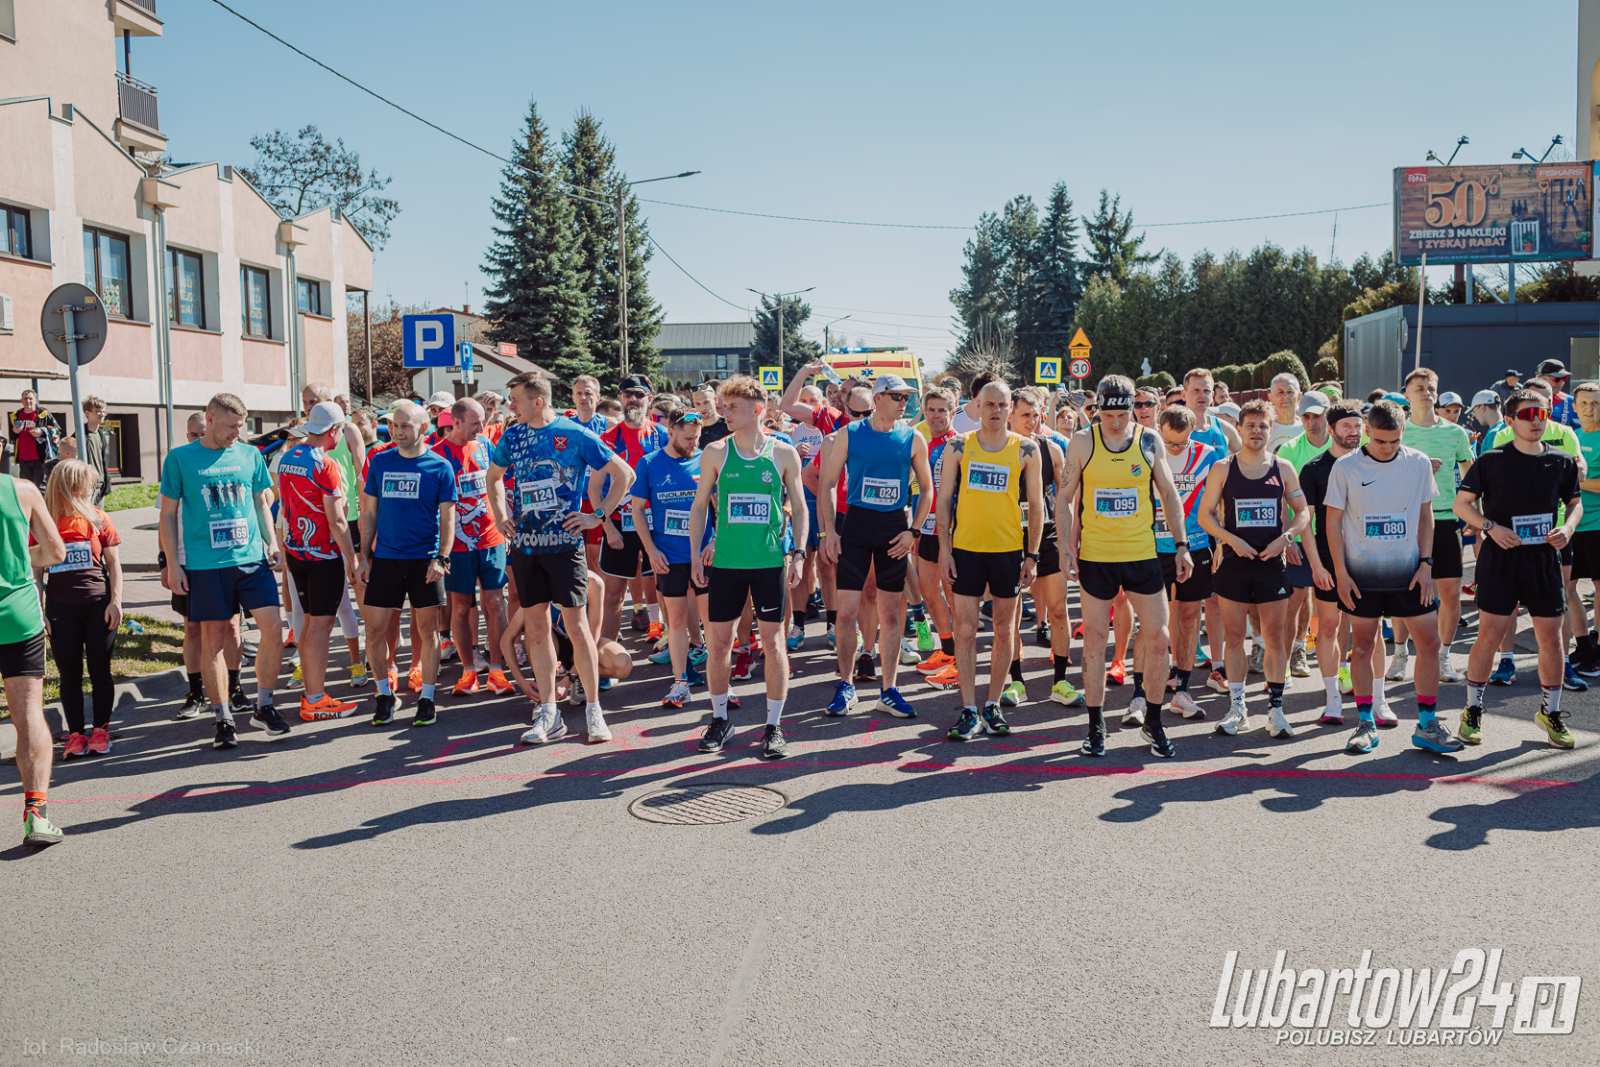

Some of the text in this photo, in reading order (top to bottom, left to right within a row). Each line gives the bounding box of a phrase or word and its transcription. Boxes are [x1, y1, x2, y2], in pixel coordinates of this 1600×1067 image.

[1409, 227, 1506, 239] ZBIERZ 3 NAKLEJKI
[1418, 237, 1507, 249] I ZYSKAJ RABAT
[415, 320, 444, 361] P
[1072, 363, 1088, 375] 30
[986, 472, 1005, 485] 115
[398, 480, 416, 492] 047
[534, 488, 553, 501] 124
[880, 487, 897, 498] 024
[747, 503, 767, 515] 108
[1114, 498, 1135, 510] 095
[1254, 507, 1274, 519] 139
[230, 527, 247, 539] 169
[1383, 522, 1404, 534] 080
[1535, 523, 1551, 536] 161
[67, 550, 89, 563] 039
